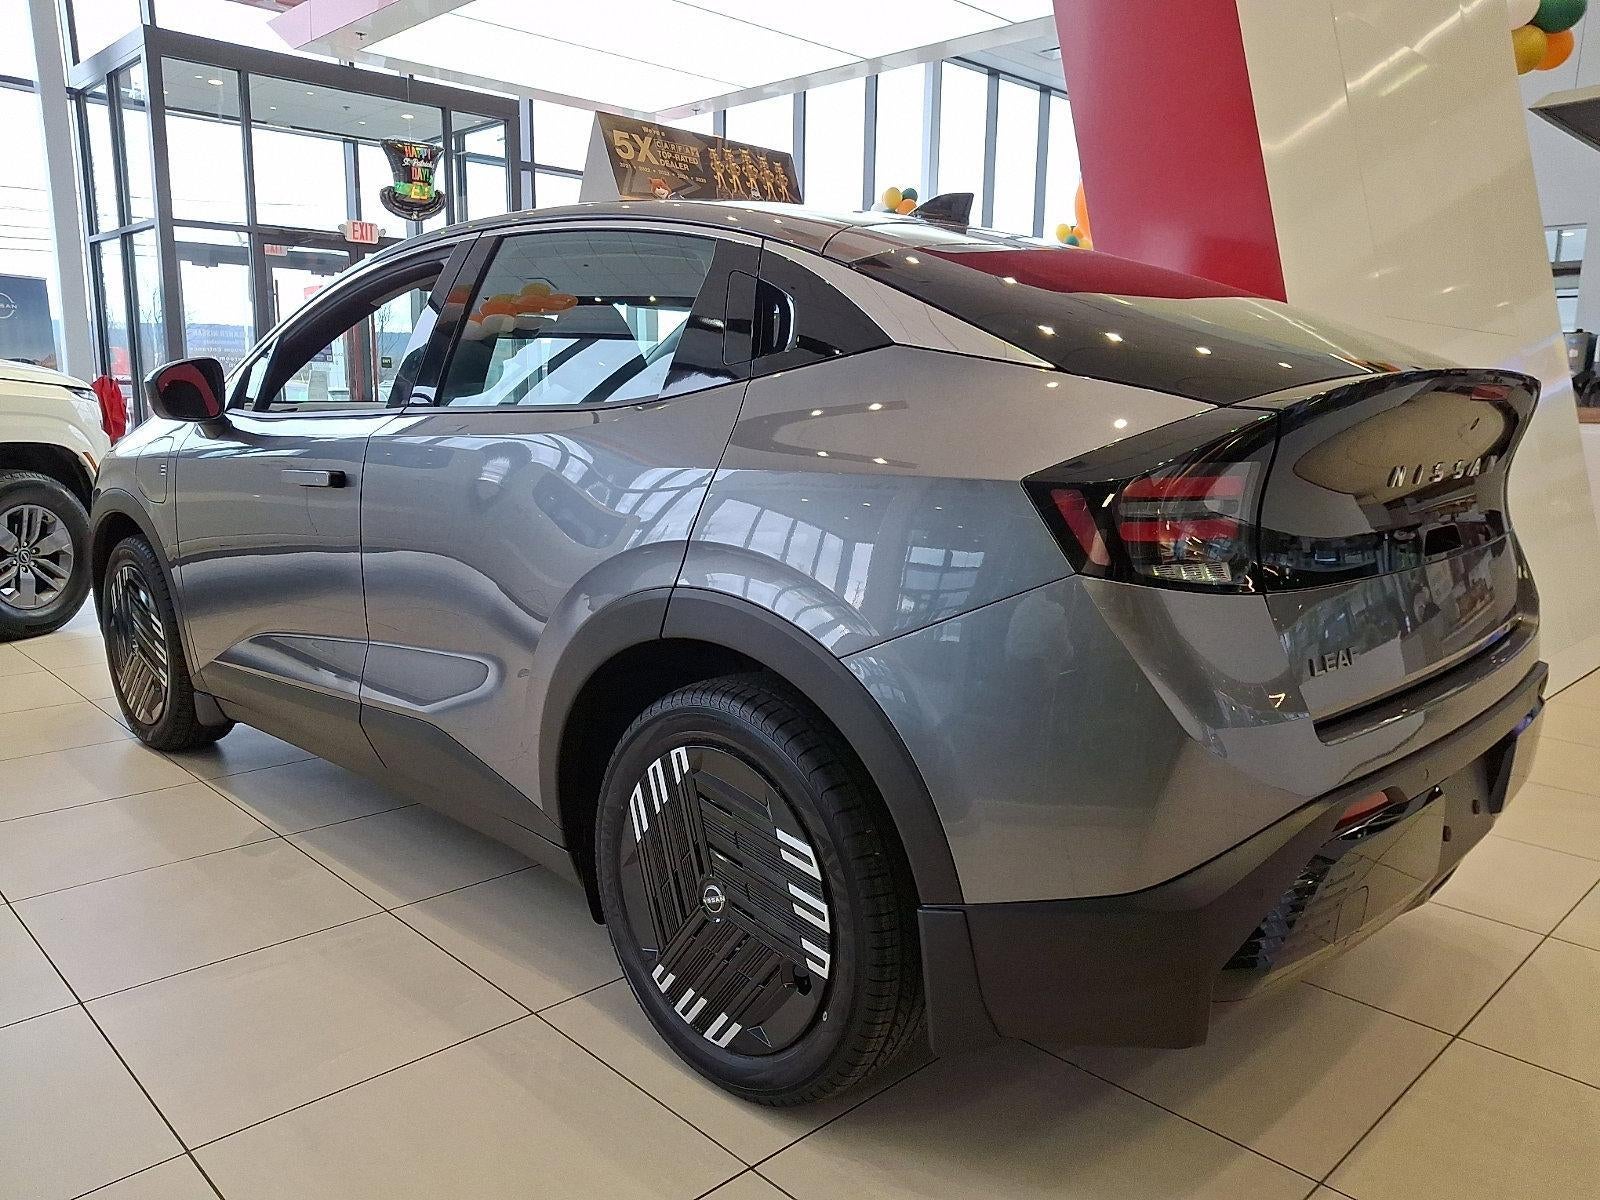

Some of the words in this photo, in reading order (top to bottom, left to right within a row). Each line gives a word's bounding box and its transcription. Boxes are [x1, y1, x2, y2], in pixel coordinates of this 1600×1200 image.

[404, 145, 431, 160] HAPPY
[612, 129, 660, 166] 5X
[656, 139, 700, 158] CARFAX
[657, 150, 699, 165] TOP-RATED
[660, 159, 690, 171] DEALER
[411, 166, 430, 182] DAY!
[352, 221, 374, 241] EXIT
[1308, 646, 1359, 677] LEAF
